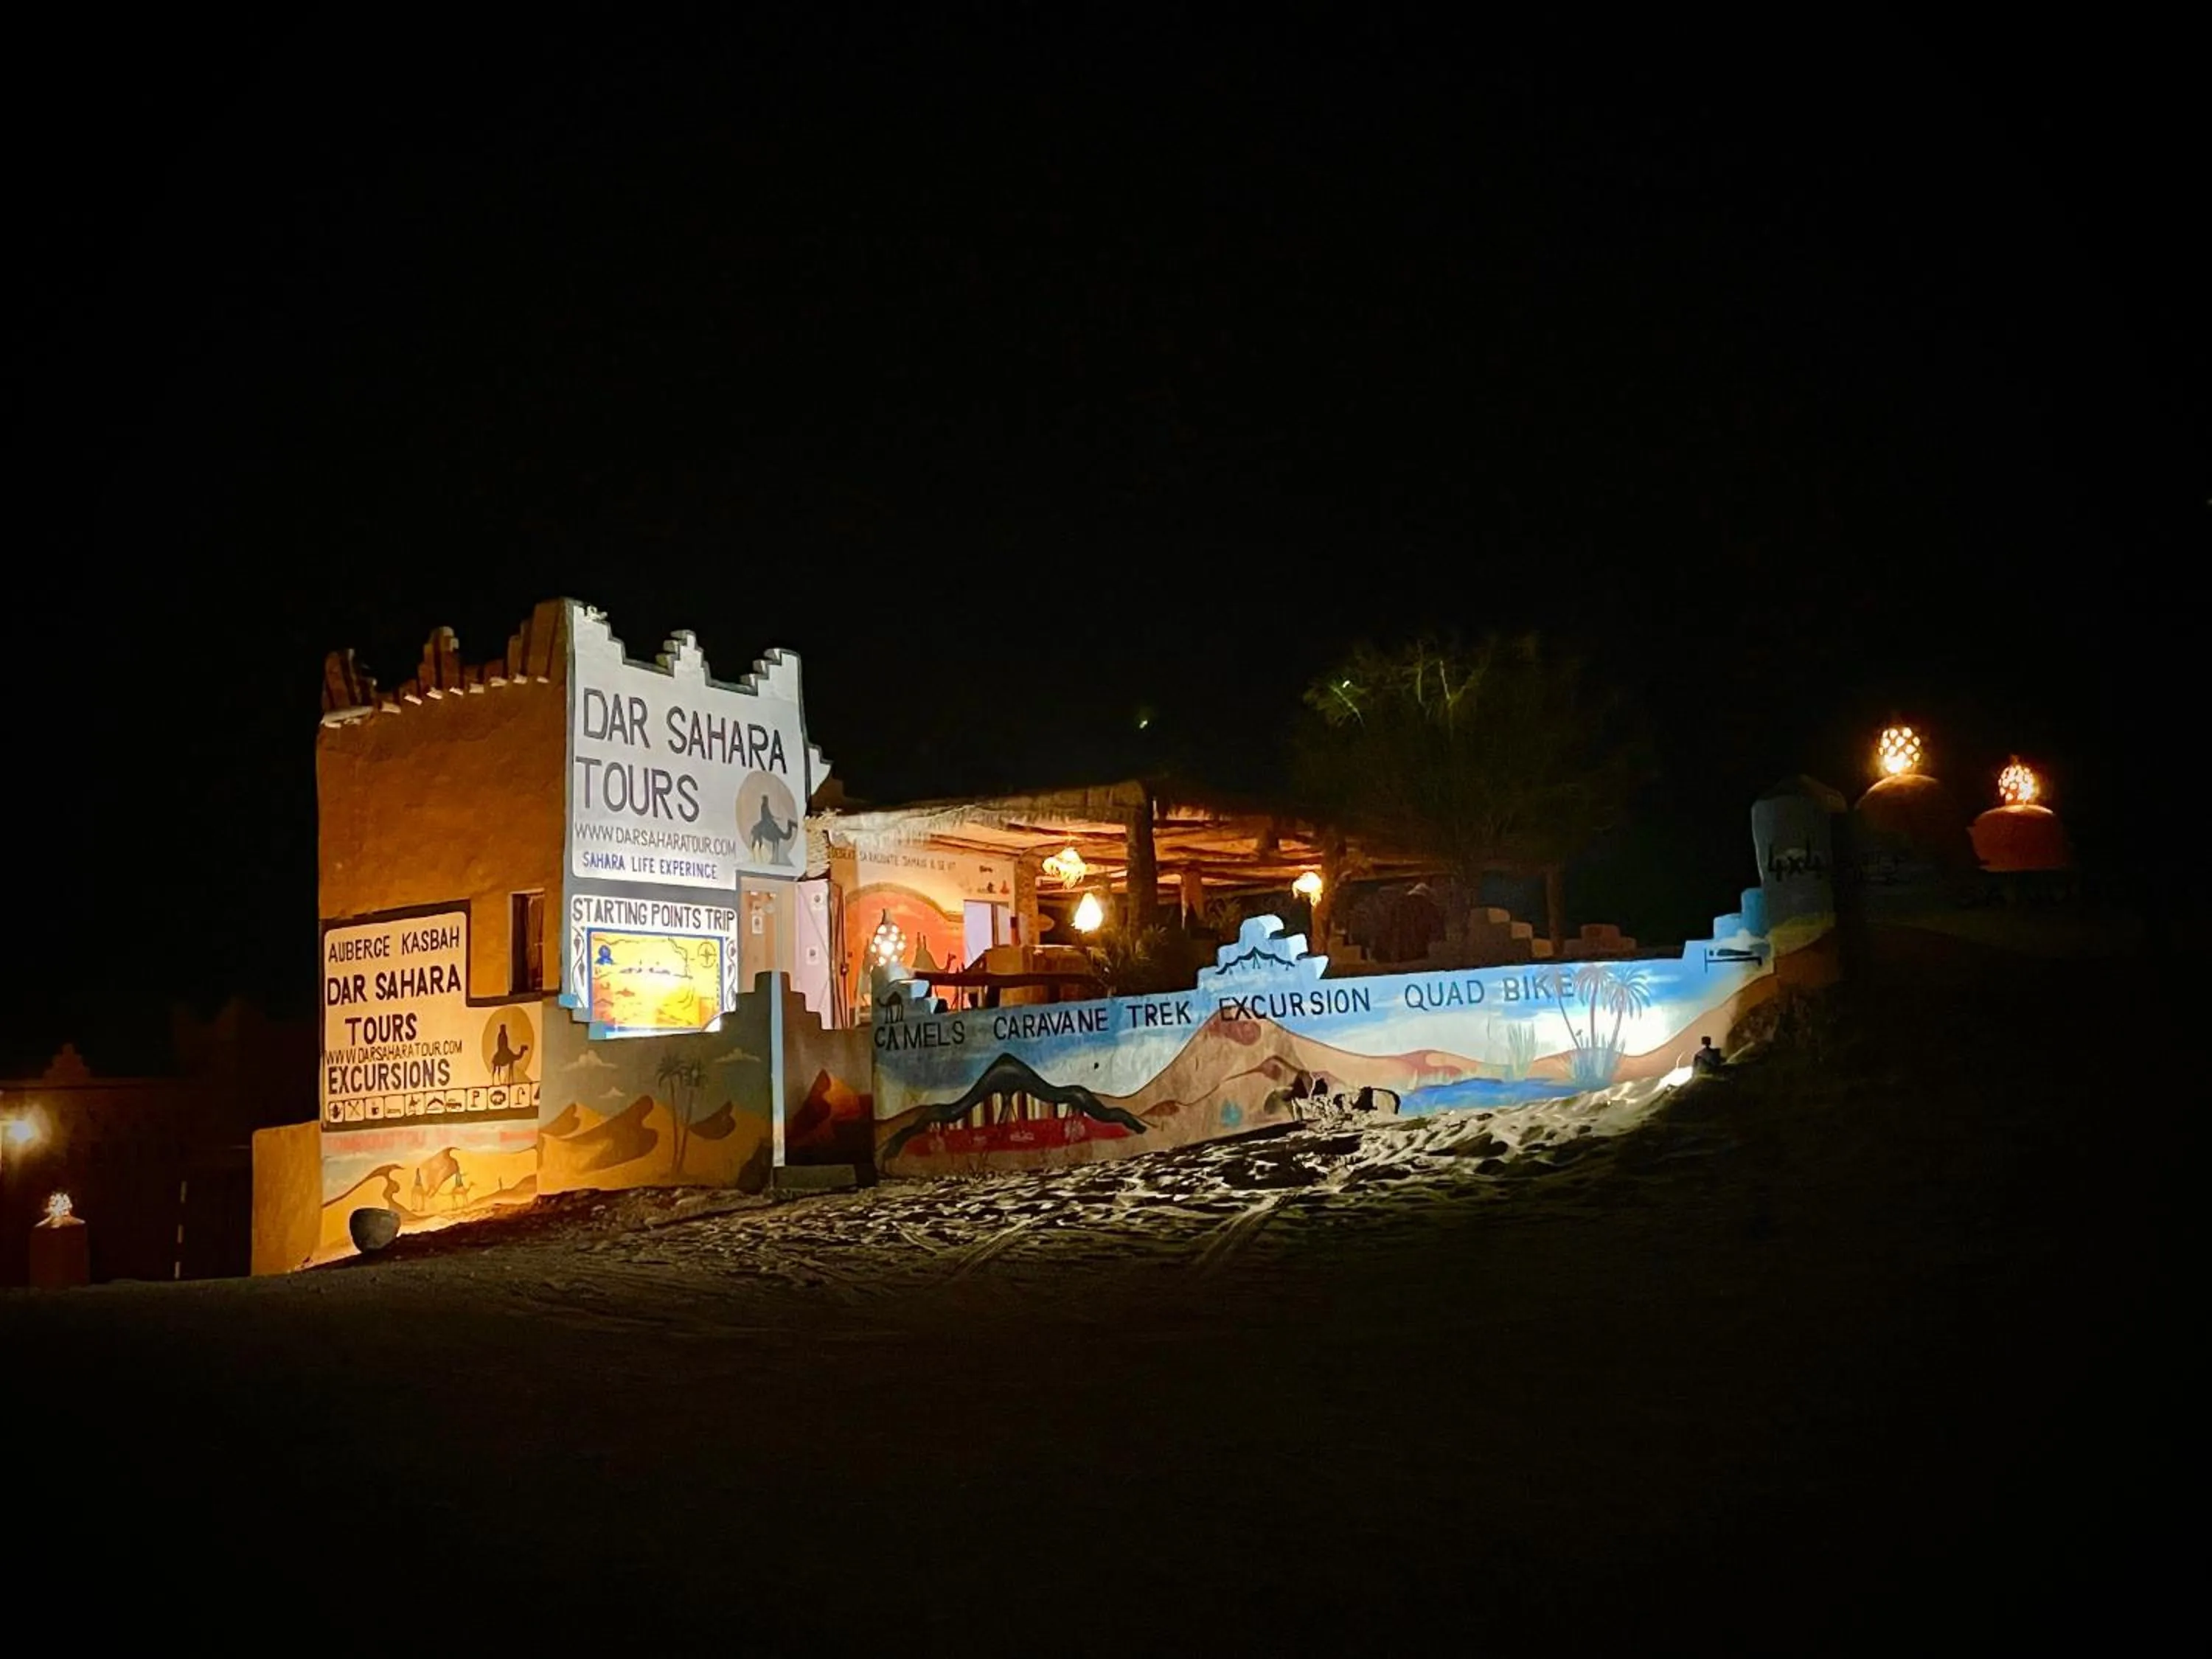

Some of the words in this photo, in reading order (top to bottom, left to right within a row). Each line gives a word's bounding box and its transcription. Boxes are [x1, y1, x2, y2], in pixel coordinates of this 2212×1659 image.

[583, 687, 651, 750] DAR
[666, 705, 787, 775] SAHARA
[575, 755, 700, 823] TOURS
[582, 851, 626, 871] SAHARA
[630, 856, 655, 874] LIFE
[659, 858, 718, 880] EXPERINCE
[571, 897, 648, 926] STARTING
[650, 902, 701, 929] POINTS
[705, 908, 736, 932] TRIP
[401, 925, 459, 956] KASBAH
[327, 973, 368, 1006] DAR
[375, 963, 462, 1001] SAHARA
[344, 1012, 418, 1046] TOURS
[874, 1020, 966, 1051] CAMELS
[993, 1006, 1109, 1041] CARAVANE
[1126, 1000, 1193, 1029] TREK
[1218, 987, 1371, 1023] EXCURSION
[1404, 978, 1486, 1012] QUAD
[1502, 973, 1574, 1001] BIKE
[327, 1058, 451, 1096] EXCURSIONS
